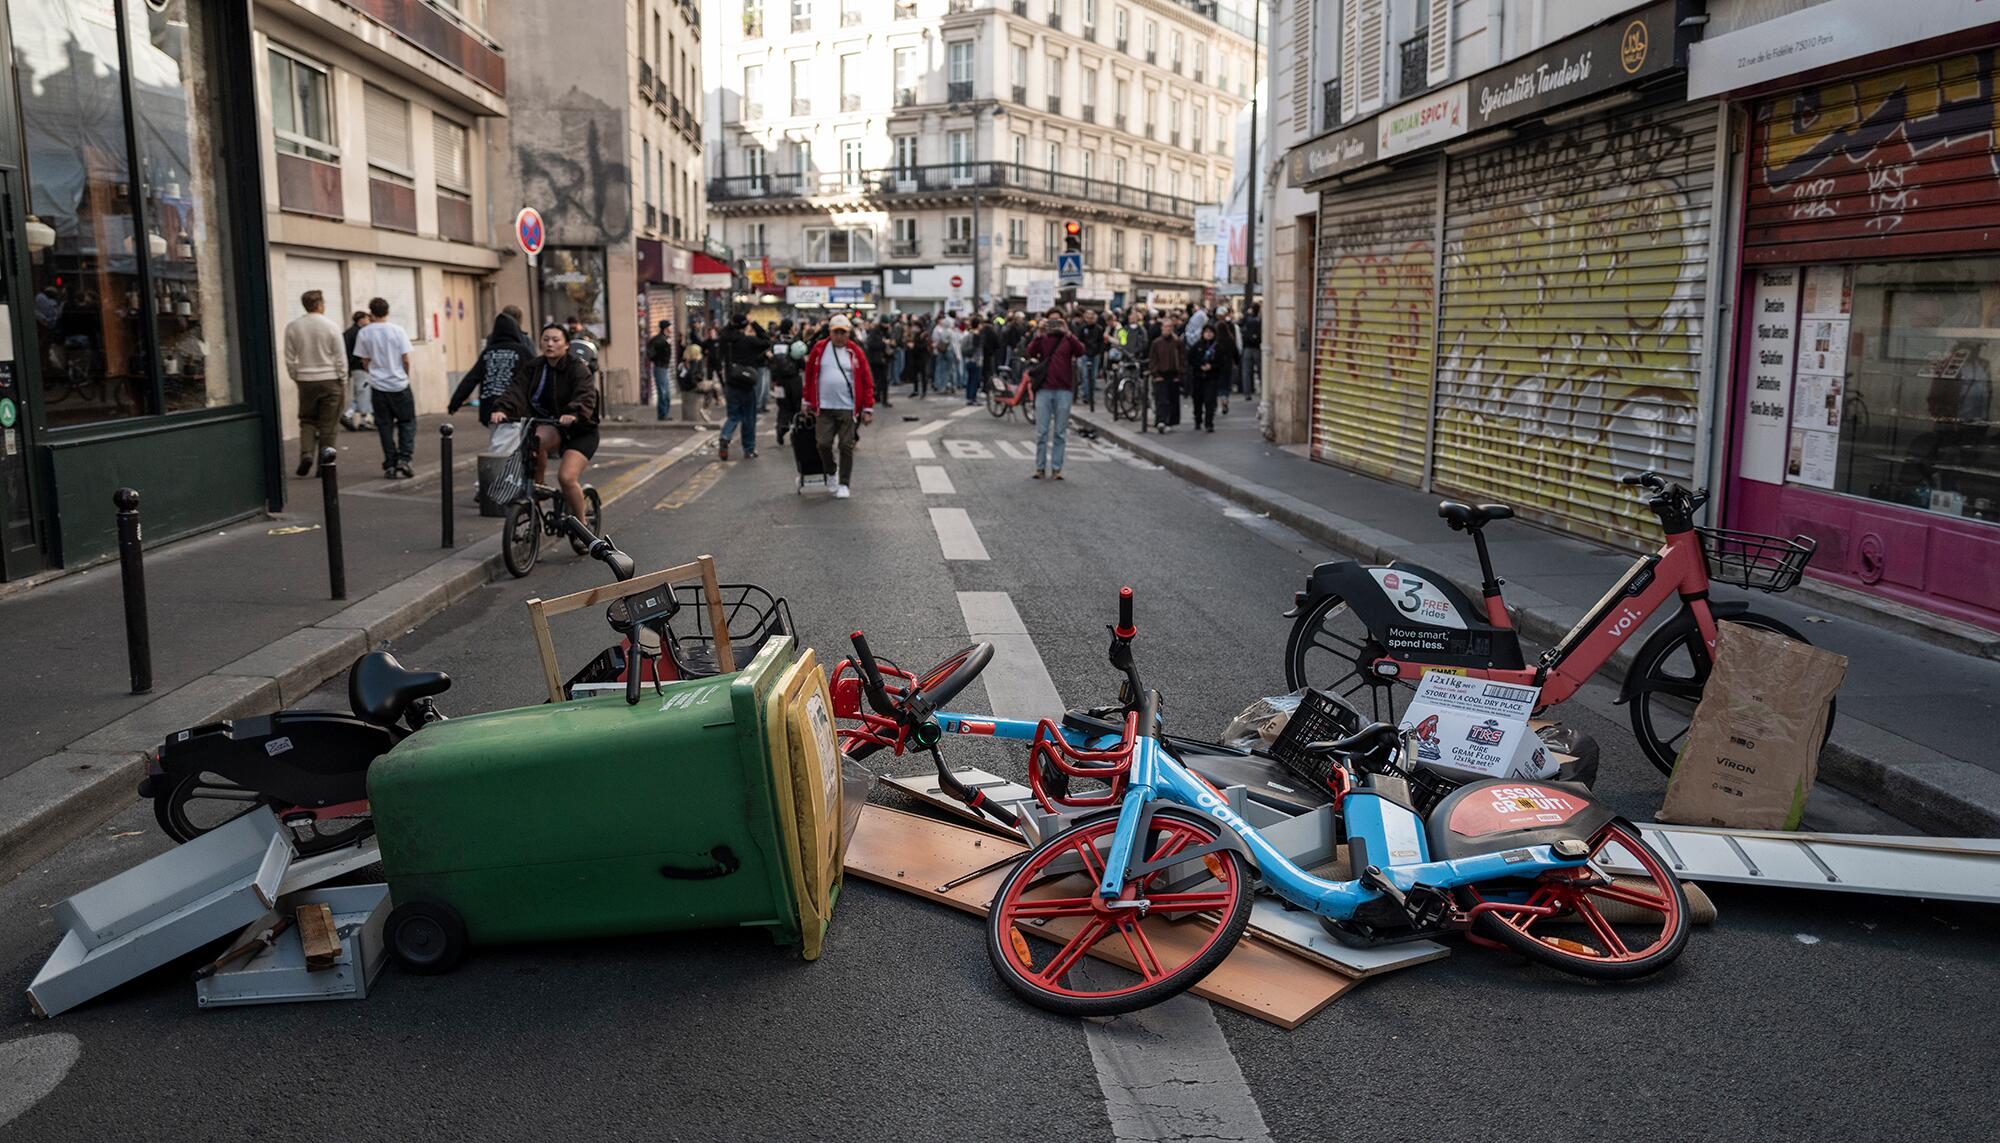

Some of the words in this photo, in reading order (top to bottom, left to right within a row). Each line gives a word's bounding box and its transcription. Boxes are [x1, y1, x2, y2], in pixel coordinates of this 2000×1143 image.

[1795, 37, 1816, 51] 75010
[1818, 32, 1834, 45] Paris
[1479, 73, 1536, 121] Spécialités
[1537, 51, 1592, 93] Tandoori
[1390, 111, 1419, 135] INDIAN
[1420, 100, 1449, 127] SPICY
[1764, 298, 1784, 312] Dentaire
[1397, 578, 1423, 612] 3
[1422, 599, 1449, 612] FREE
[1420, 608, 1446, 619] rides
[1389, 628, 1415, 638] Move
[1388, 639, 1420, 649] spend
[1422, 640, 1445, 650] less.
[1430, 675, 1462, 689] 12x1kg
[1425, 689, 1448, 698] STORE
[1463, 695, 1482, 704] COOL
[1484, 699, 1499, 708] DRY
[1500, 701, 1523, 711] PLACE
[1471, 726, 1502, 743] TRS
[1451, 746, 1475, 758] GRAM
[1475, 752, 1501, 763] FLOUR
[1469, 744, 1488, 753] PURE
[1453, 754, 1475, 765] 12x1kg
[1476, 759, 1488, 767] net
[1716, 756, 1756, 775] VIRON
[1490, 787, 1546, 801] ESSAI
